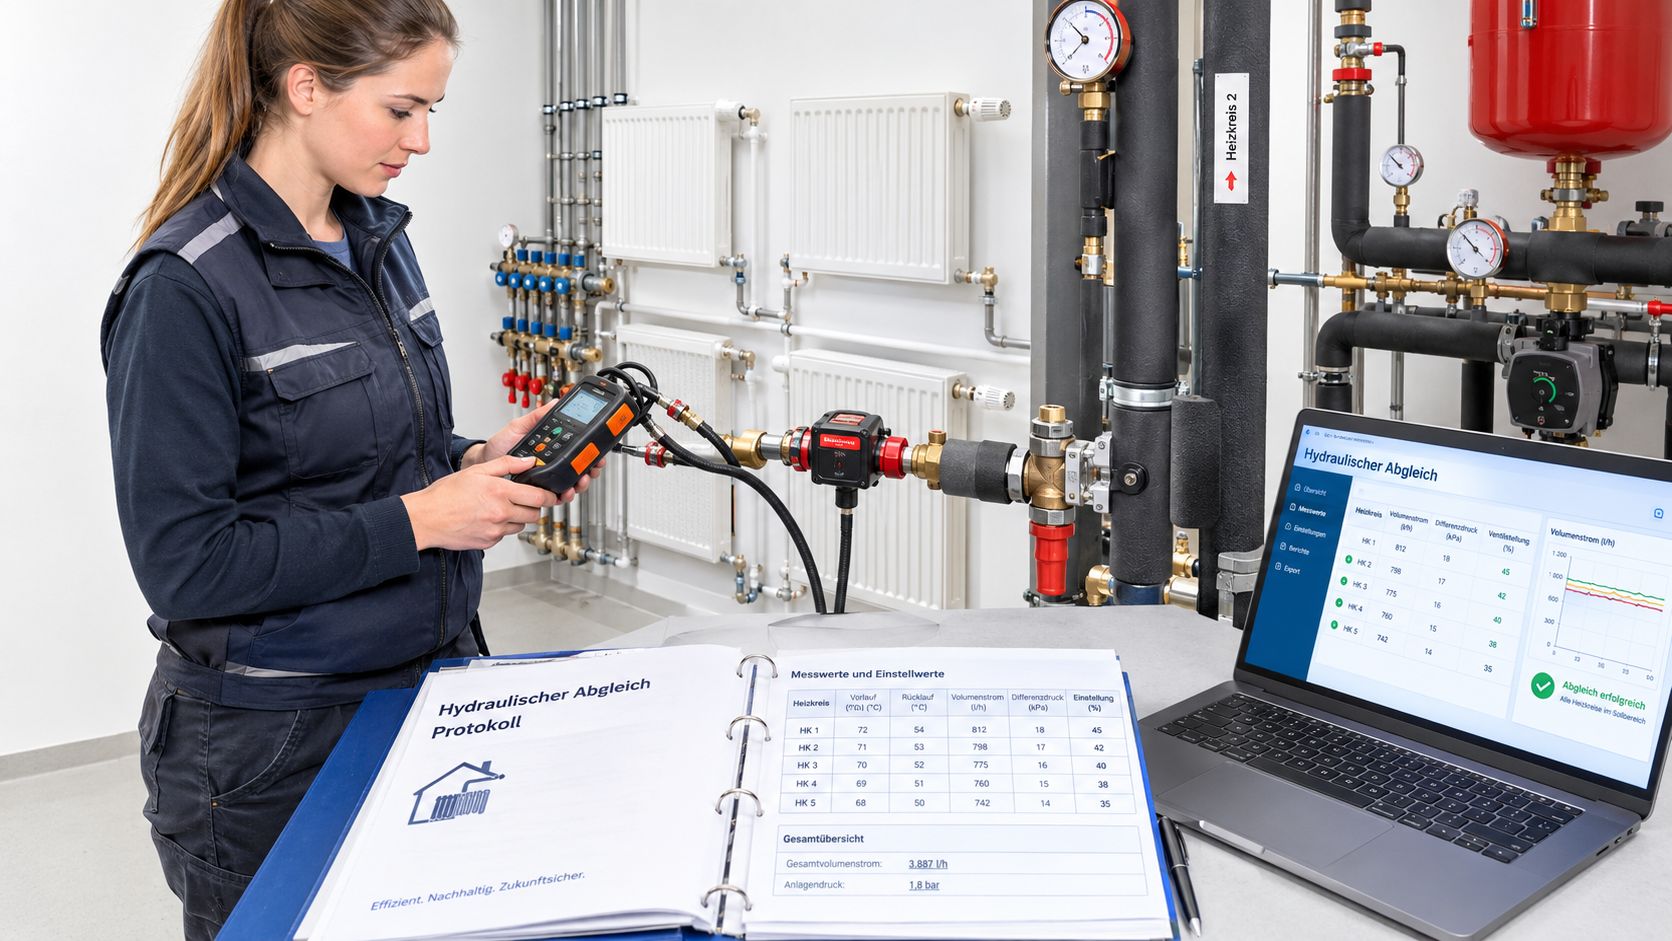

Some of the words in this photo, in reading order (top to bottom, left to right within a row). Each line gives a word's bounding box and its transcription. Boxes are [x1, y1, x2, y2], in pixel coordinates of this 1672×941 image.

[1226, 104, 1236, 160] Heizkreis
[1304, 448, 1384, 472] Hydraulischer
[1384, 462, 1438, 482] Abgleich
[1304, 486, 1326, 496] Übersicht
[1298, 504, 1326, 517] Messwerte
[1294, 524, 1326, 538] Einstellungen
[1390, 510, 1428, 524] Volumenstrom
[1434, 520, 1478, 534] Differenzdruck
[1488, 530, 1530, 546] Ventilstellung
[1550, 528, 1600, 545] Volumenstrom
[1600, 538, 1616, 548] (l/h)
[1284, 565, 1300, 574] Export
[1395, 544, 1406, 552] 812
[1443, 554, 1450, 562] 18
[1502, 568, 1510, 576] 45
[1357, 558, 1366, 567] HK
[1498, 592, 1506, 600] 42
[1352, 580, 1362, 588] HK
[1386, 589, 1397, 598] 775
[1434, 601, 1441, 609] 16
[1493, 616, 1502, 624] 40
[1348, 602, 1358, 611] HK
[1430, 624, 1436, 632] 15
[1488, 640, 1497, 648] 38
[1343, 624, 1353, 633] HK
[1353, 627, 1358, 635] 5
[1376, 634, 1388, 643] 742
[1484, 664, 1492, 672] 35
[790, 670, 850, 679] Messwerte
[852, 669, 873, 679] und
[875, 669, 945, 679] Einstellwerte
[438, 688, 569, 717] Hydraulischer
[572, 678, 651, 700] Abgleich
[1074, 694, 1114, 703] Einstellung
[1562, 680, 1598, 698] Abgleich
[1600, 690, 1646, 711] erfolgreich
[866, 704, 882, 712] (°C)
[911, 704, 928, 712] (°C)
[970, 704, 986, 712] (l/h)
[1028, 704, 1048, 712] (kPa)
[1088, 704, 1102, 712] (%)
[1560, 696, 1570, 706] Alle
[1572, 698, 1602, 714] Heizkreise
[1604, 706, 1611, 716] im
[1612, 709, 1646, 725] Sollbereich
[432, 716, 522, 740] Protokoll
[796, 780, 810, 788] HK
[810, 780, 818, 788] 4
[856, 780, 867, 788] 69
[914, 780, 924, 788] 51
[974, 780, 990, 788] 760
[1040, 780, 1049, 788] 15
[1098, 780, 1109, 788] 38
[795, 799, 808, 807] HK
[810, 799, 816, 807] 5
[855, 799, 866, 807] 68
[914, 799, 925, 807] 50
[974, 799, 990, 807] 742
[1040, 800, 1050, 808] 14
[1100, 800, 1111, 808] 35
[783, 834, 864, 844] Gesamtübersicht
[786, 860, 883, 868] Gesamtvolumenstrom:
[936, 860, 948, 869] l/h
[370, 896, 424, 911] Effizient.
[428, 884, 496, 902] Nachhaltig.
[499, 871, 586, 892] Zukunftsicher.
[784, 880, 845, 890] Anlagendruck:
[909, 880, 922, 891] 1,8
[925, 881, 940, 890] bar
